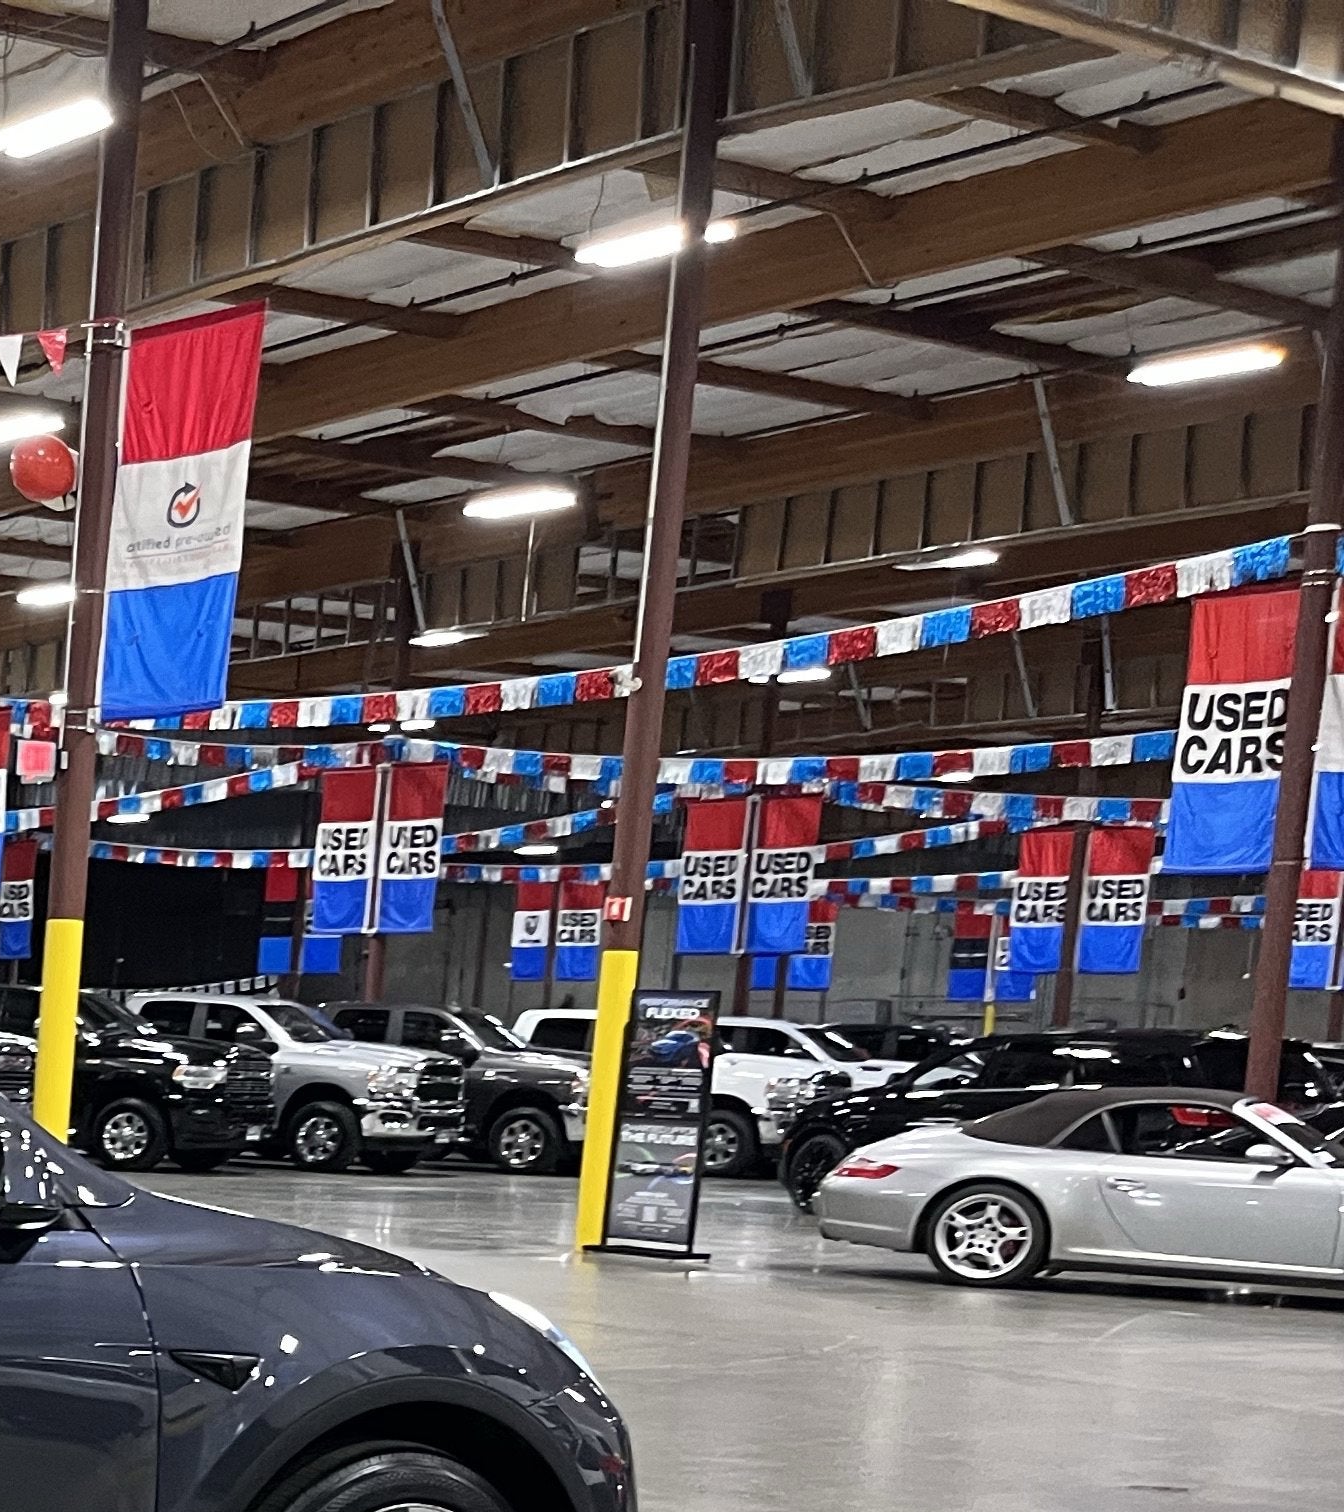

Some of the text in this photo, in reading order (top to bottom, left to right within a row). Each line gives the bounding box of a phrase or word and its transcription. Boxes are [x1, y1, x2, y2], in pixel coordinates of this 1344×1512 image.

[1188, 688, 1289, 732] USED
[1180, 731, 1286, 775] CARS
[683, 855, 738, 877] USED
[756, 852, 812, 874] USED
[682, 878, 736, 900] CARS
[752, 876, 809, 898] CARS
[1088, 879, 1144, 899] USED
[1086, 902, 1142, 922] CARS
[1294, 903, 1333, 922] SED
